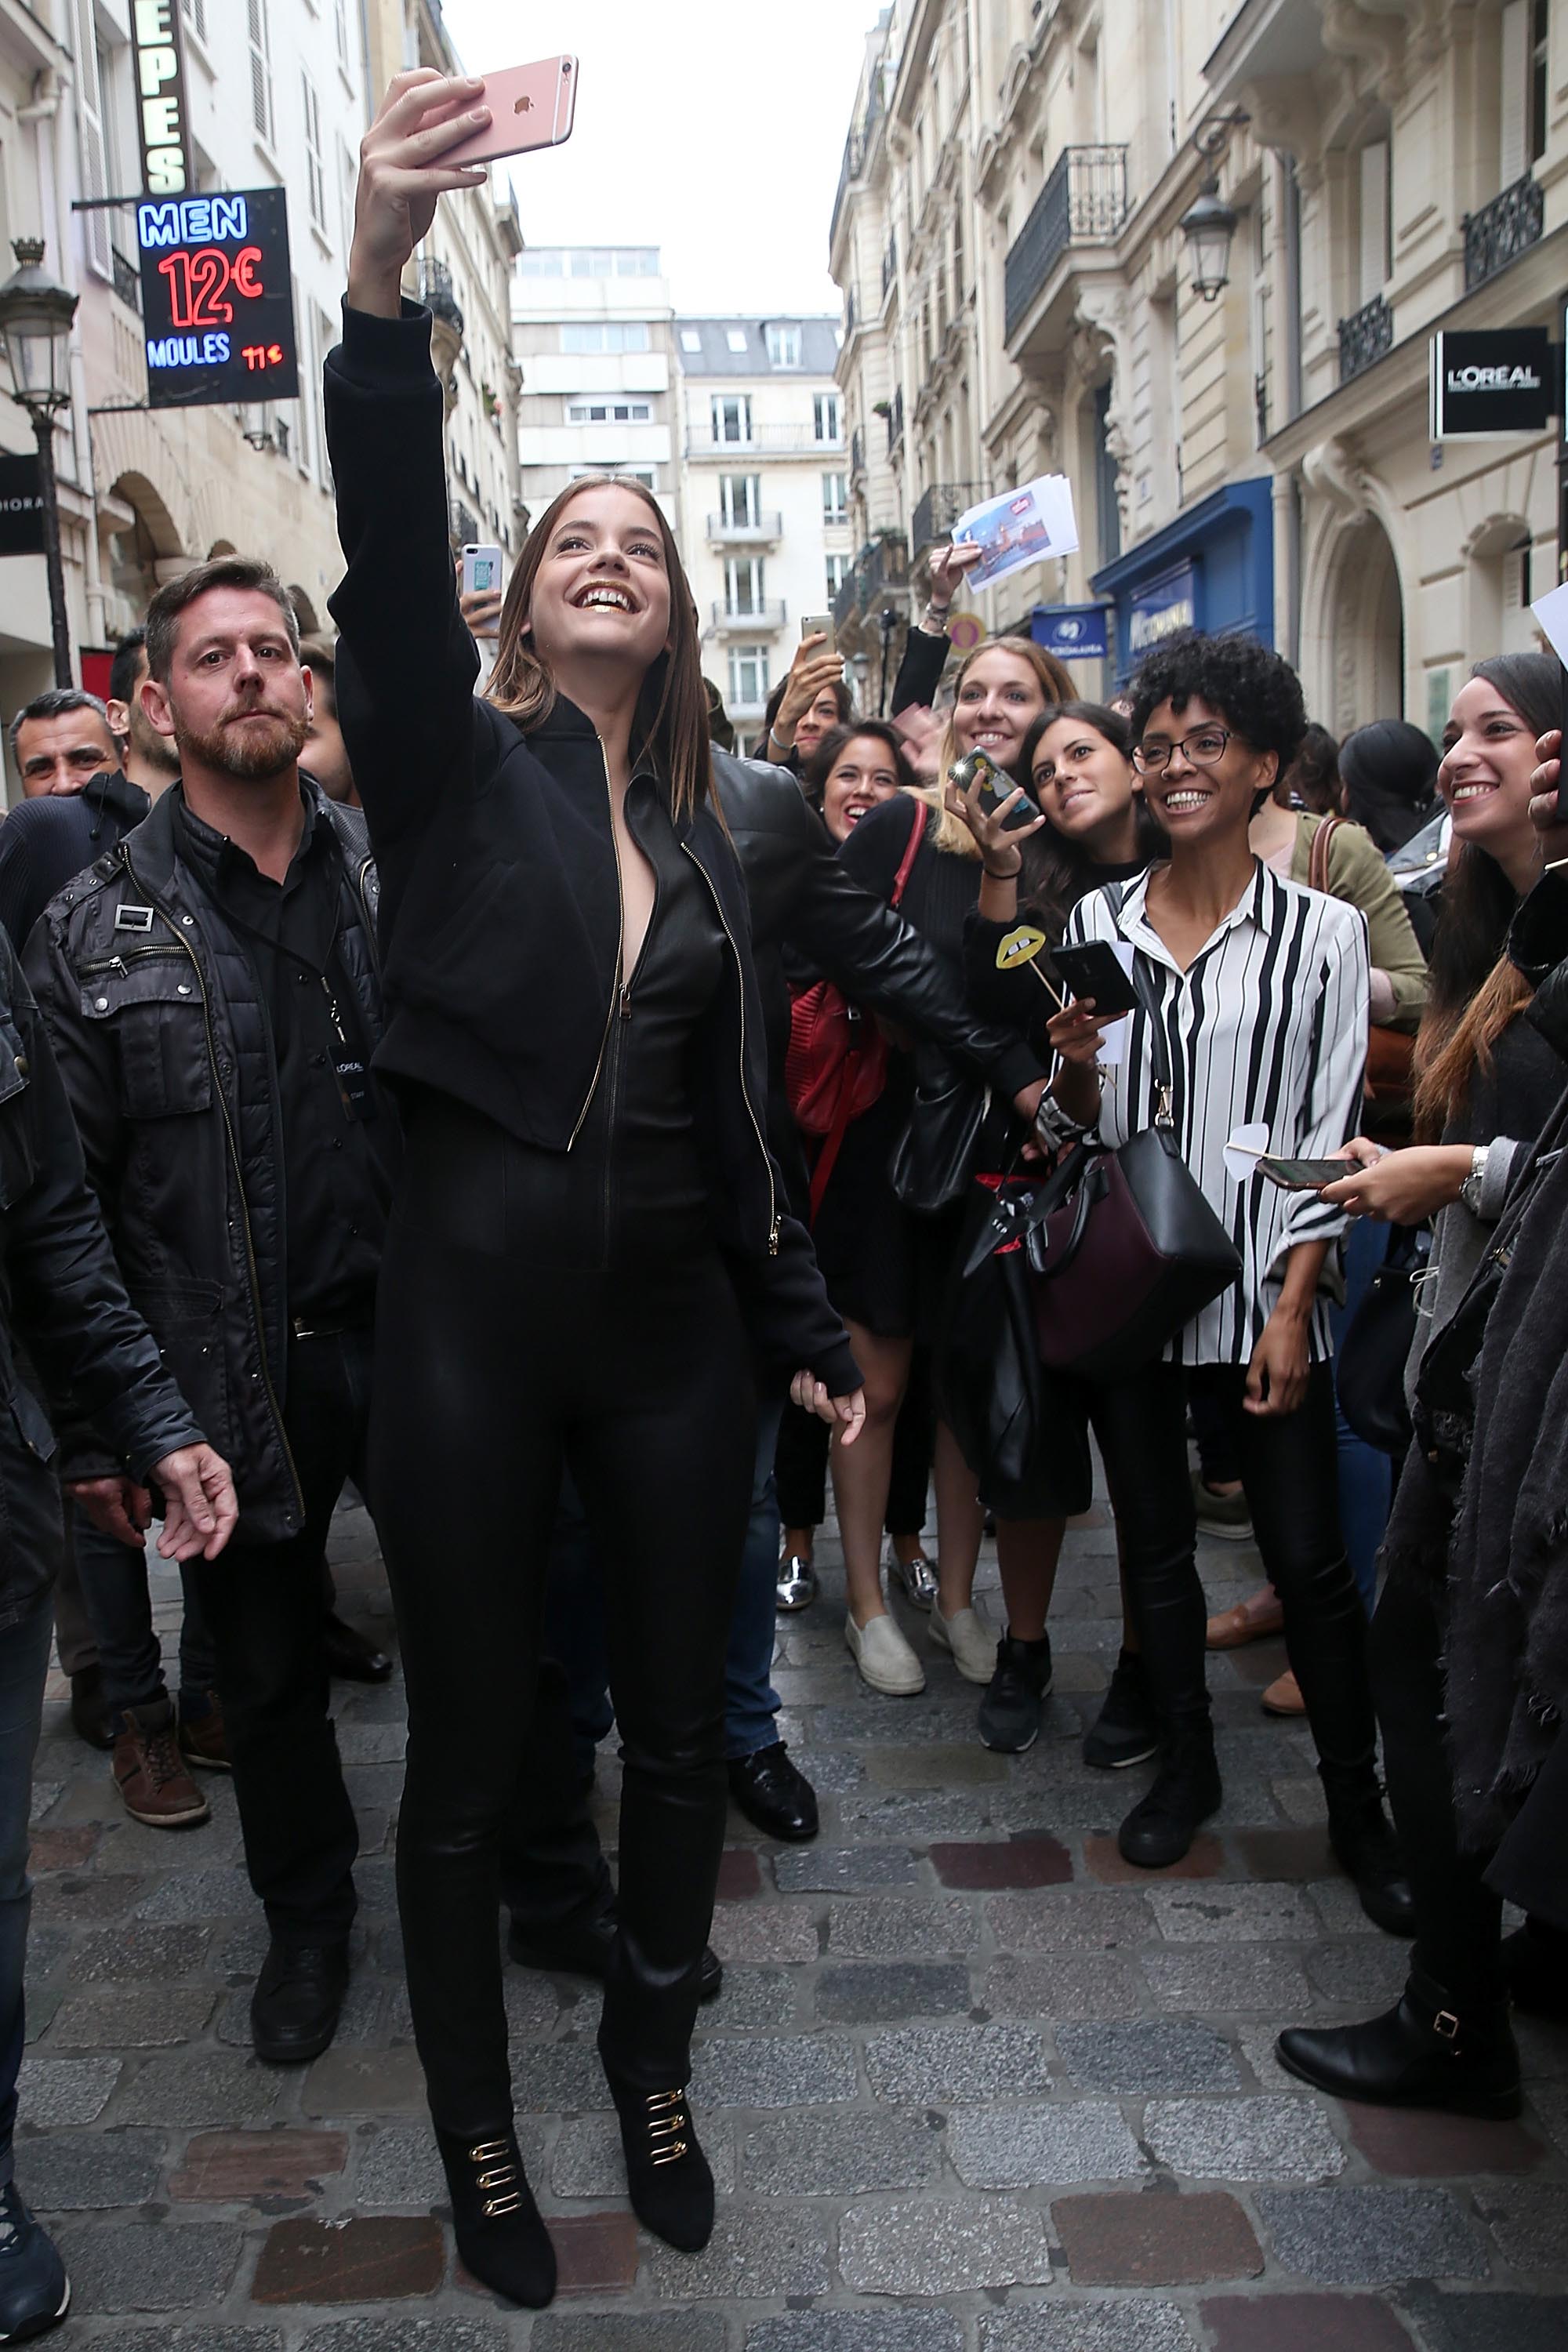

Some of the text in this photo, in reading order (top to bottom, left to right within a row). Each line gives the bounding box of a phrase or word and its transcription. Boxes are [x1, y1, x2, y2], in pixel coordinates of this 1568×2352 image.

[138, 196, 248, 248] MEN
[158, 245, 263, 328] 12€
[147, 332, 230, 368] MOULES
[0, 496, 44, 512] IORA
